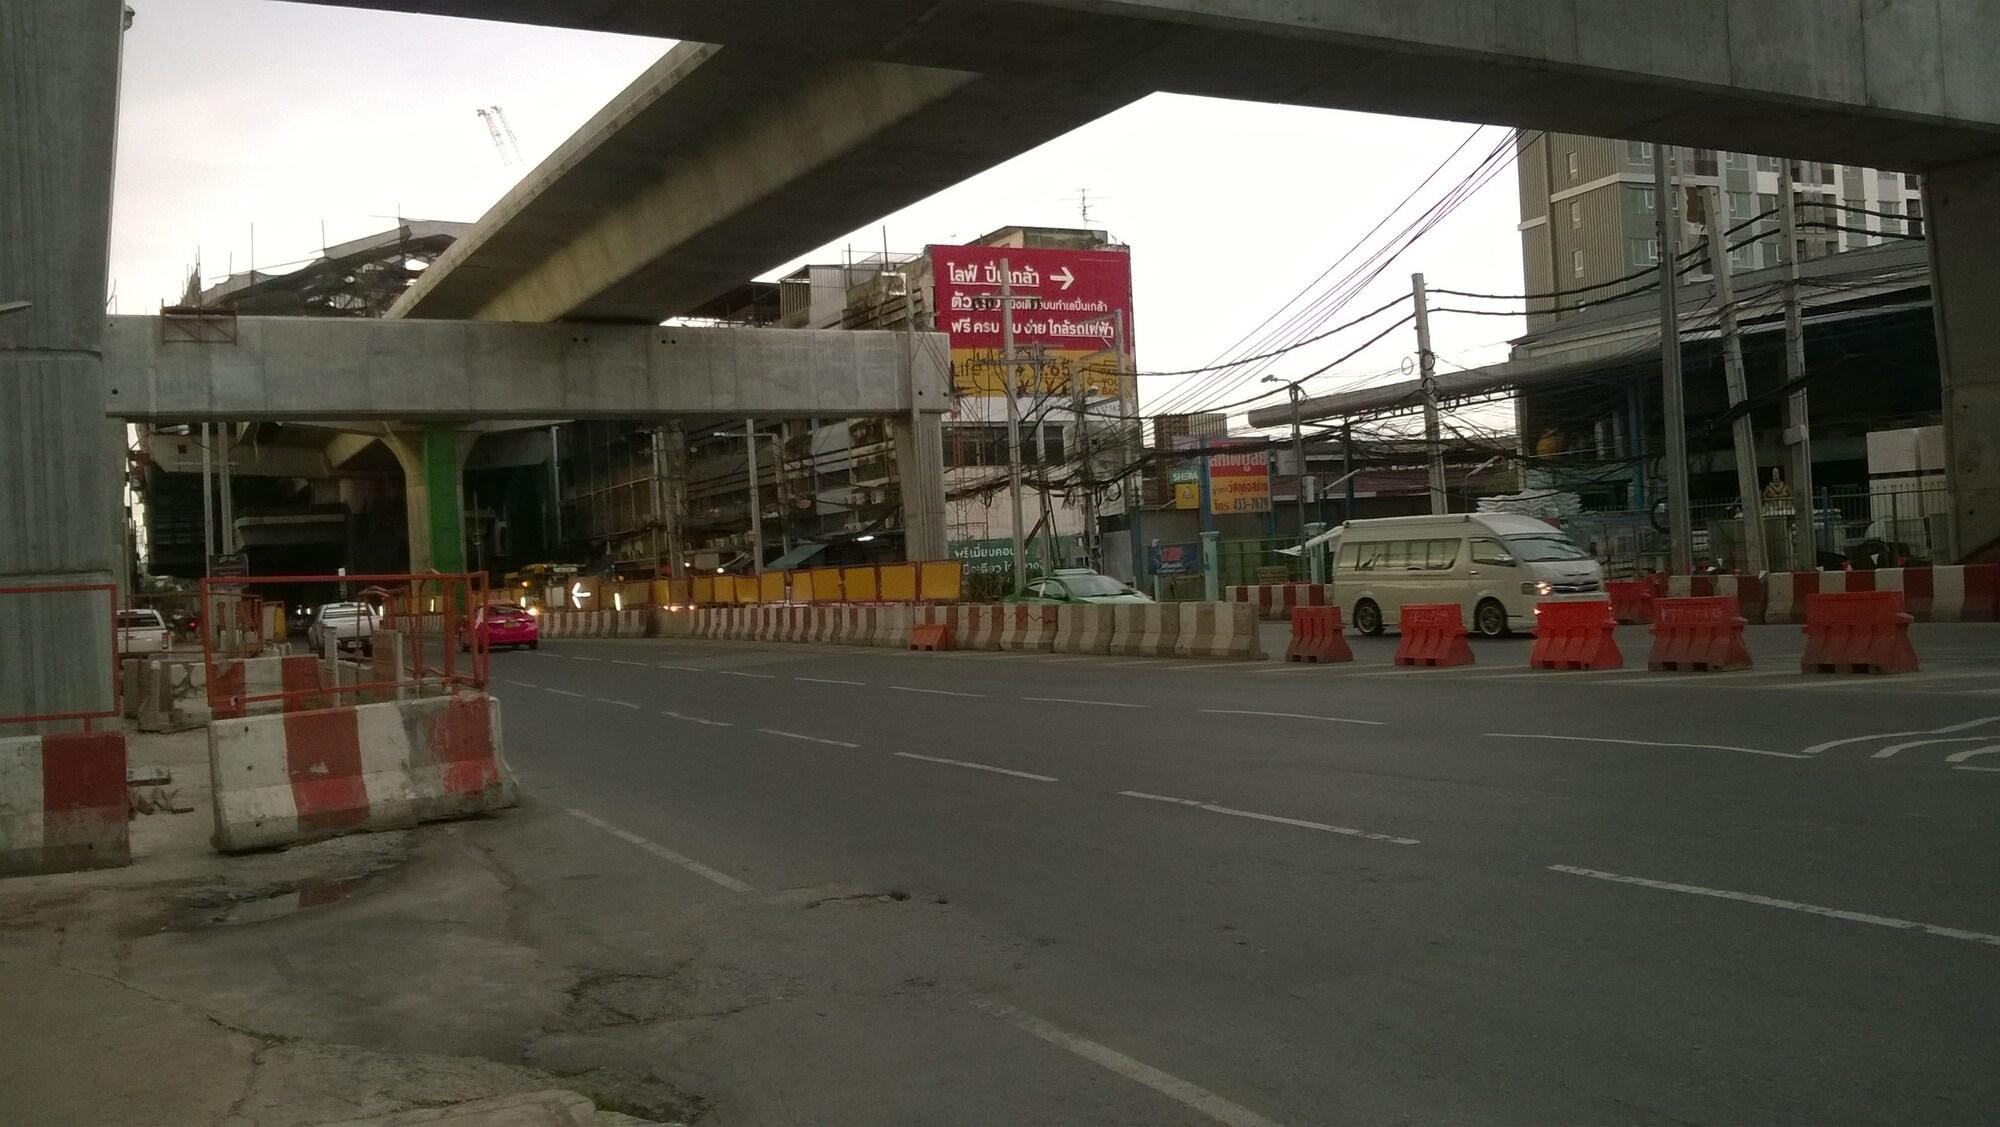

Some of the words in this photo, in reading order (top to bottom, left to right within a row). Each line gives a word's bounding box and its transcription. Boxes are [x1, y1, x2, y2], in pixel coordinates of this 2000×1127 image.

[947, 262, 978, 282] ไลฟ์
[951, 318, 971, 333] ฟรี
[973, 321, 1000, 334] ครบ
[1023, 319, 1046, 335] ง่าย
[1048, 318, 1114, 337] ใกล้รถไฟฟ้า
